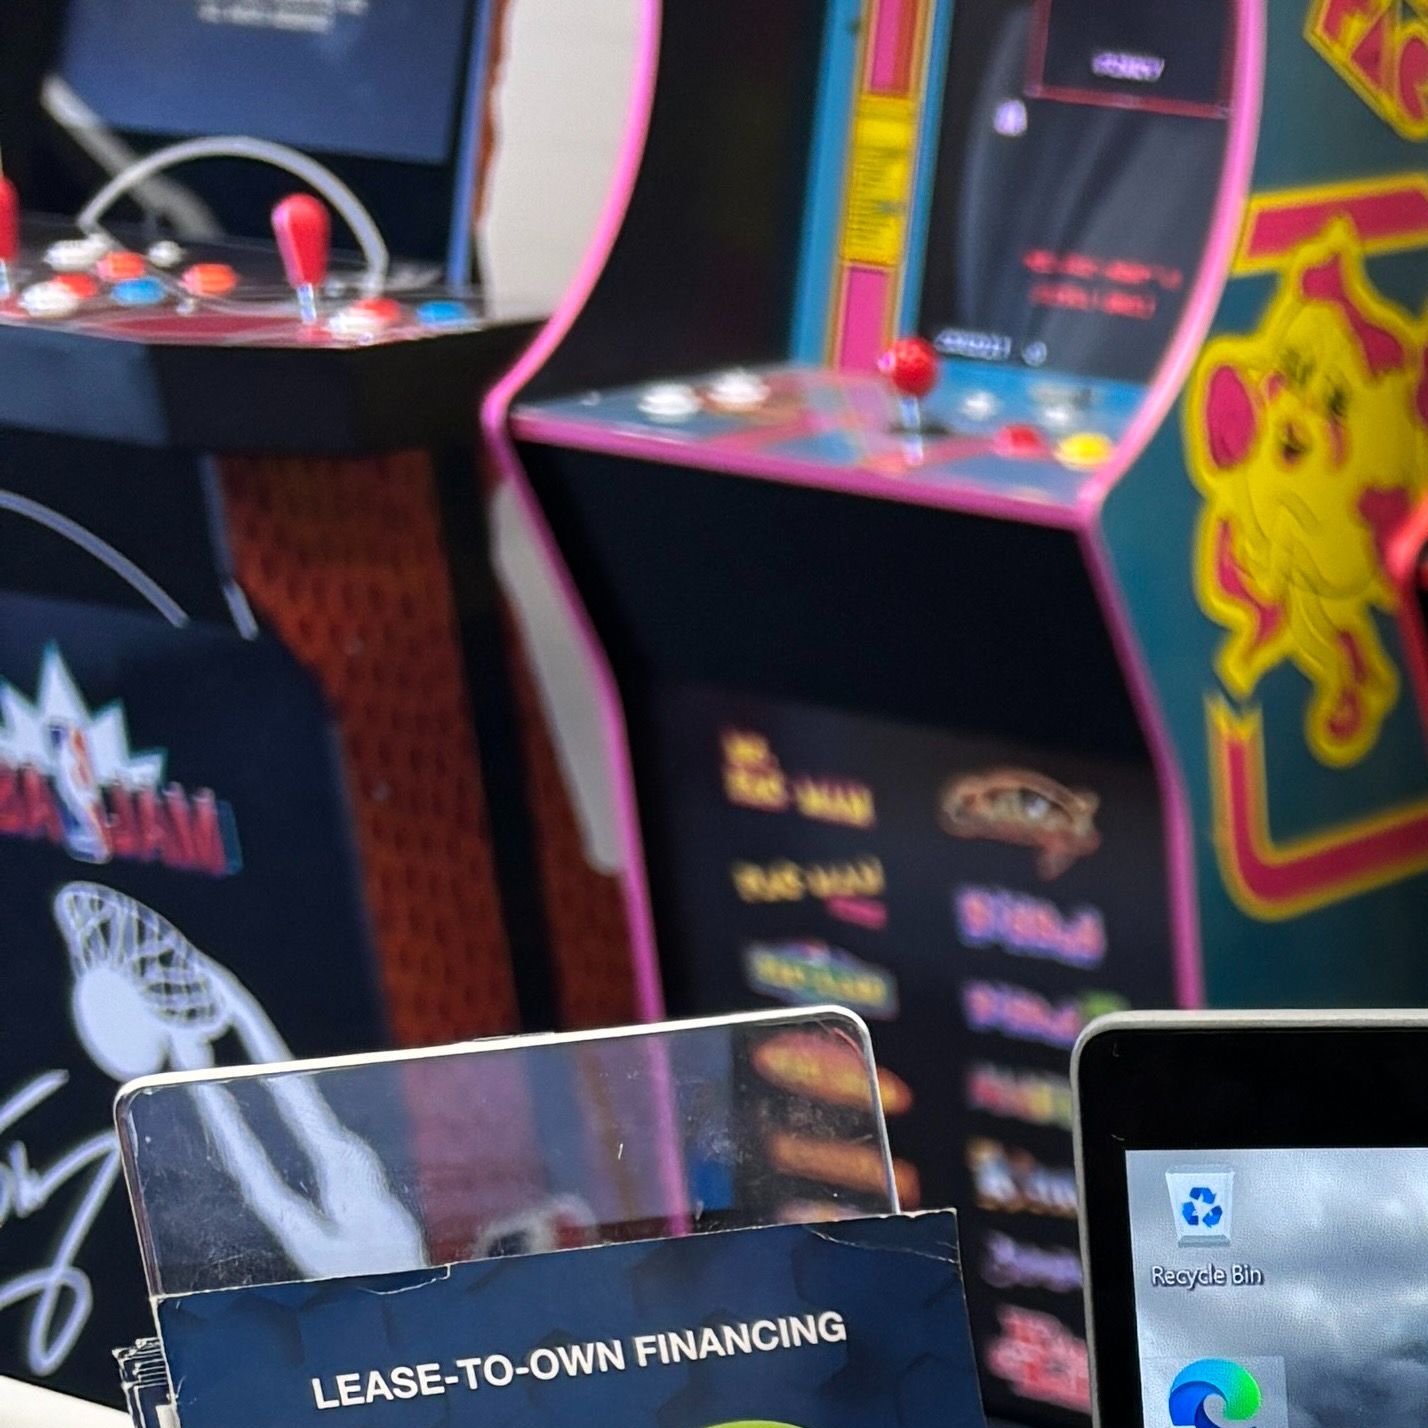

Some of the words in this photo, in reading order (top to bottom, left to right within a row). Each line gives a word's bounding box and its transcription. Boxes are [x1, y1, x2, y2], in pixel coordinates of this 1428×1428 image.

[1152, 1264, 1225, 1289] Recycle
[1228, 1264, 1260, 1287] Bin
[312, 1340, 626, 1410] LEASE-TO-OWN
[634, 1311, 848, 1369] FINANCING
